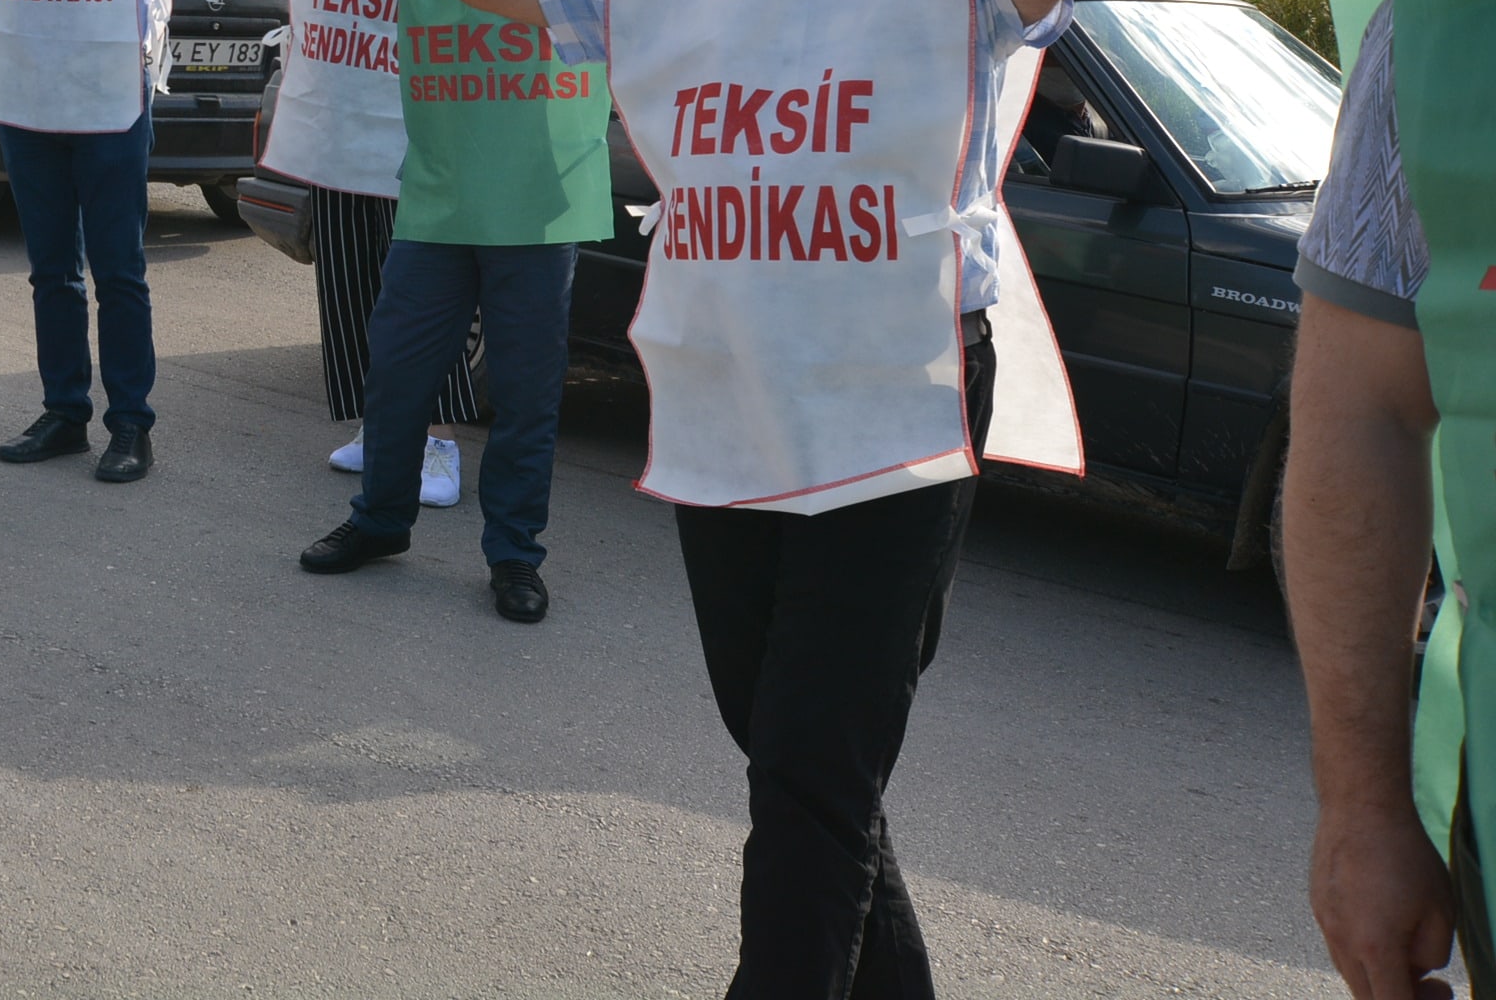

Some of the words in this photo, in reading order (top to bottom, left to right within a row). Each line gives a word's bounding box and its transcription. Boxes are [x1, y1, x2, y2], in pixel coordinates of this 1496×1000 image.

[165, 42, 182, 62] 4
[191, 42, 221, 62] EY
[228, 42, 261, 63] 183
[409, 67, 590, 102] SENDİKASI
[671, 68, 874, 157] TEKSİF
[664, 166, 898, 263] SENDİKASI
